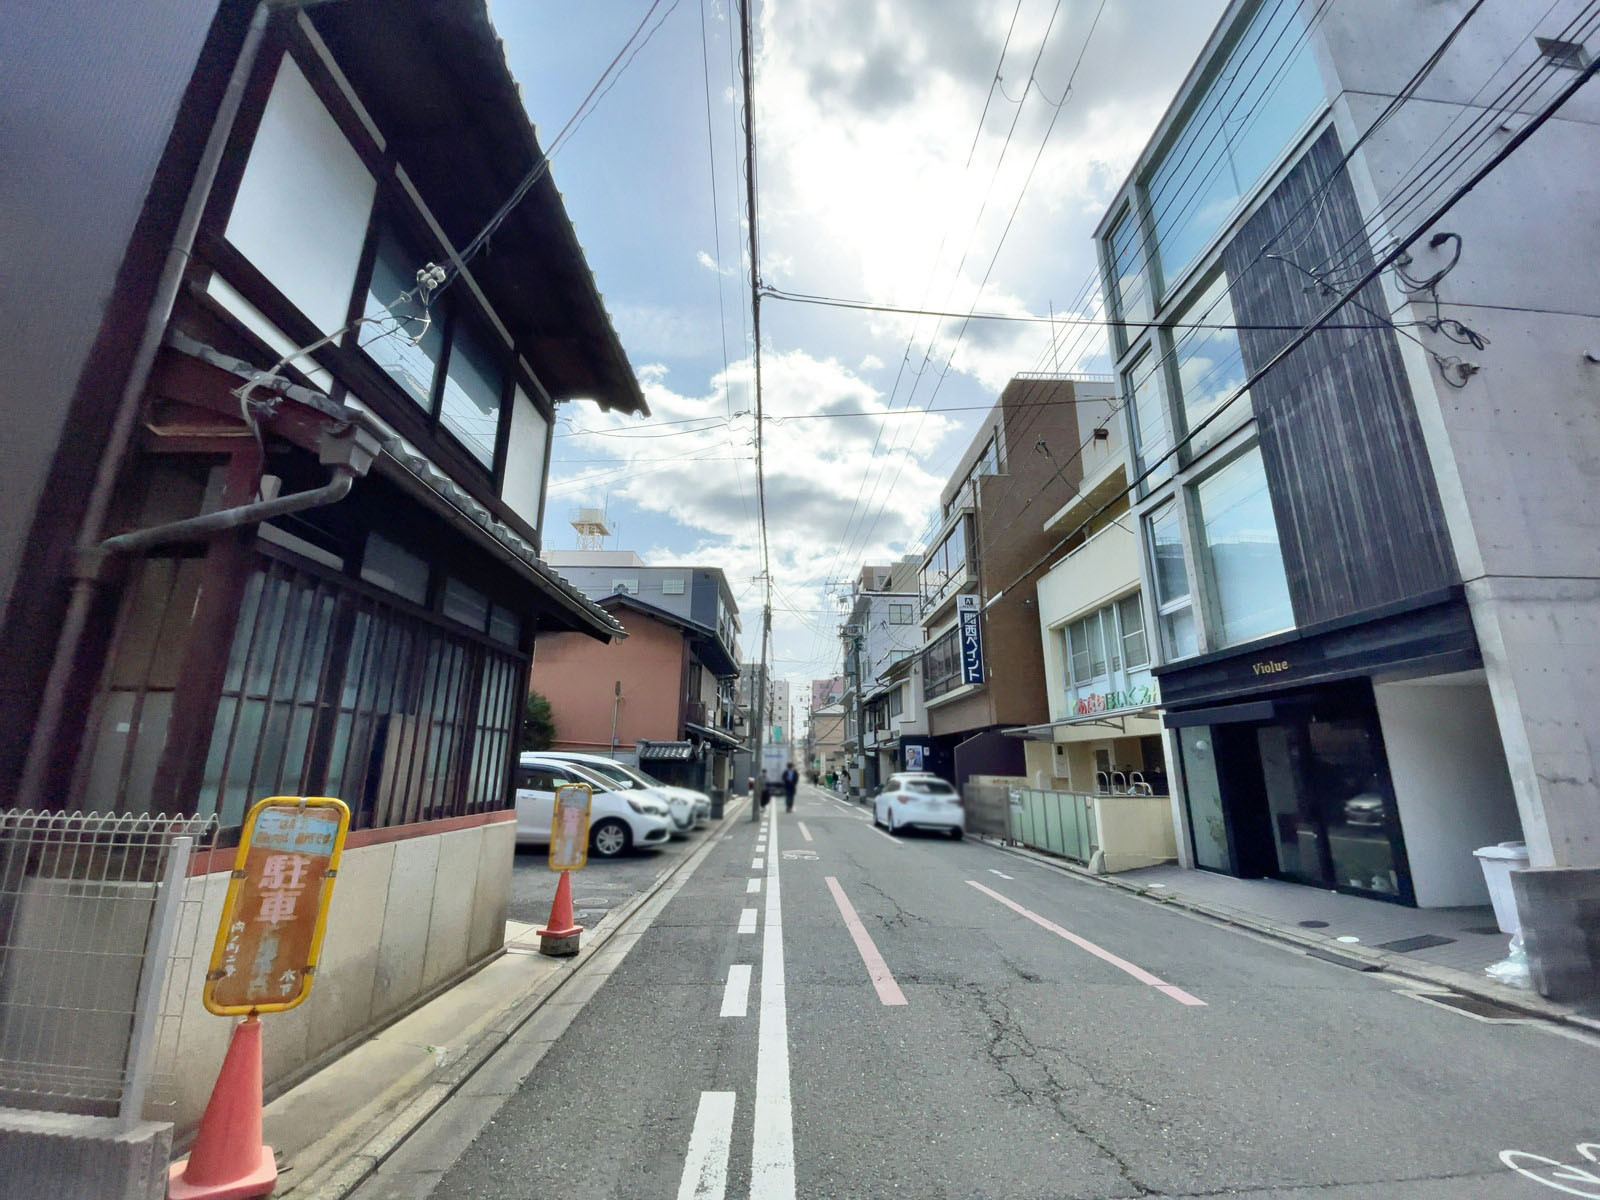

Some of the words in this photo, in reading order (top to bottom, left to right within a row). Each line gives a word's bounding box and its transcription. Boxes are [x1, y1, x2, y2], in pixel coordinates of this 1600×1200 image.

[964, 613, 980, 681] 関西ペイント
[1252, 660, 1288, 676] Violue
[255, 855, 311, 923] 駐車
